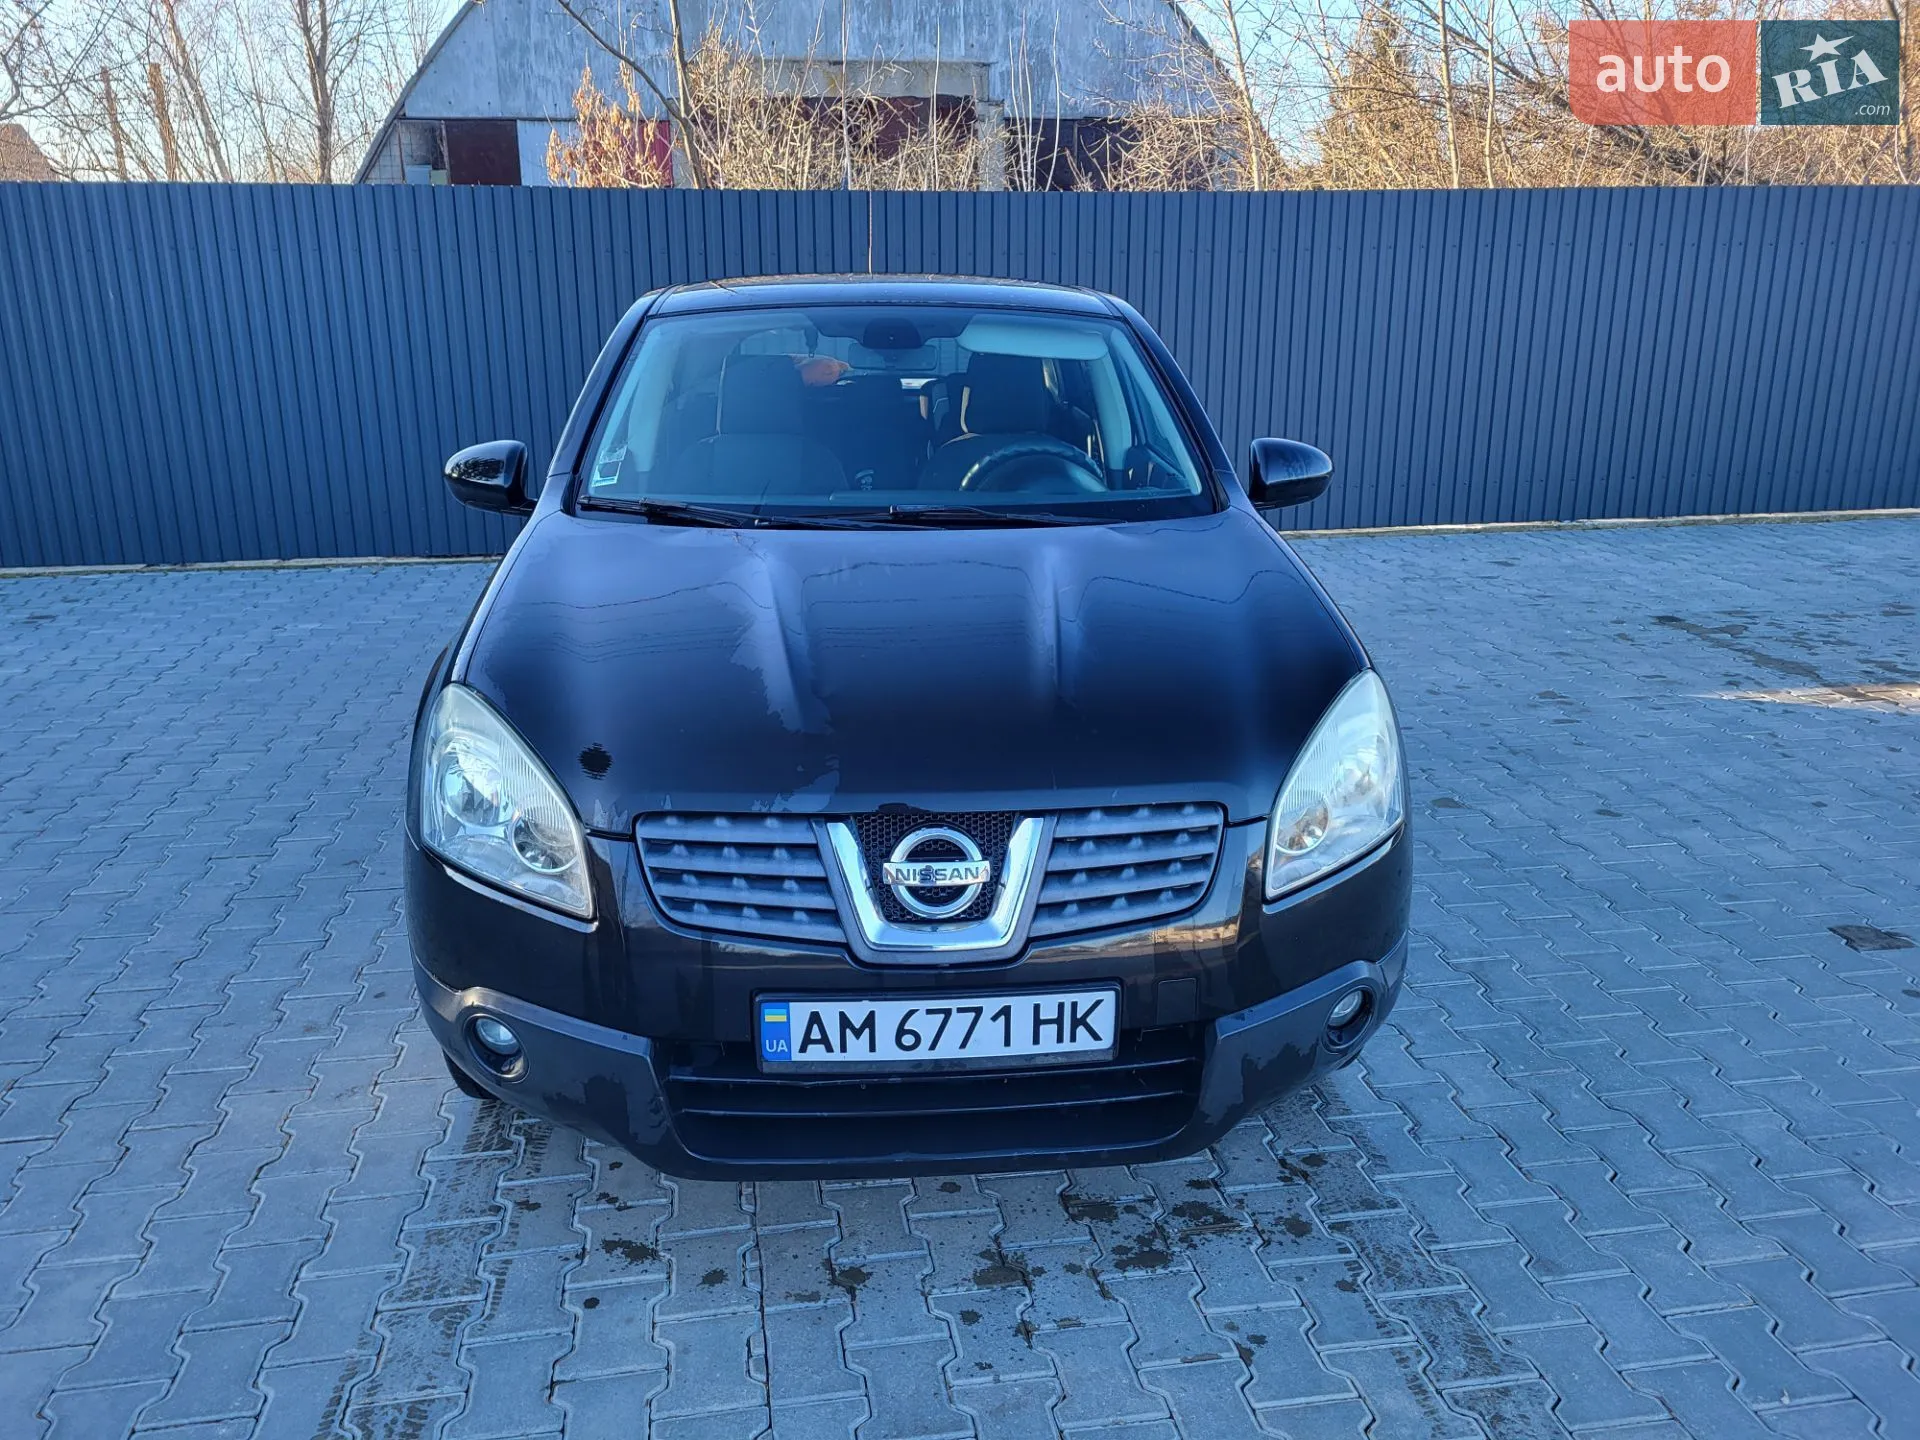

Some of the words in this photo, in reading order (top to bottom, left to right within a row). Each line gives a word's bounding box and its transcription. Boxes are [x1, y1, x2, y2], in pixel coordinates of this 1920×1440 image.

[895, 867, 979, 882] NISSAN
[798, 1010, 877, 1054] AM
[894, 1004, 1012, 1052] 6771
[1032, 998, 1106, 1046] HK
[765, 1039, 788, 1053] UA
